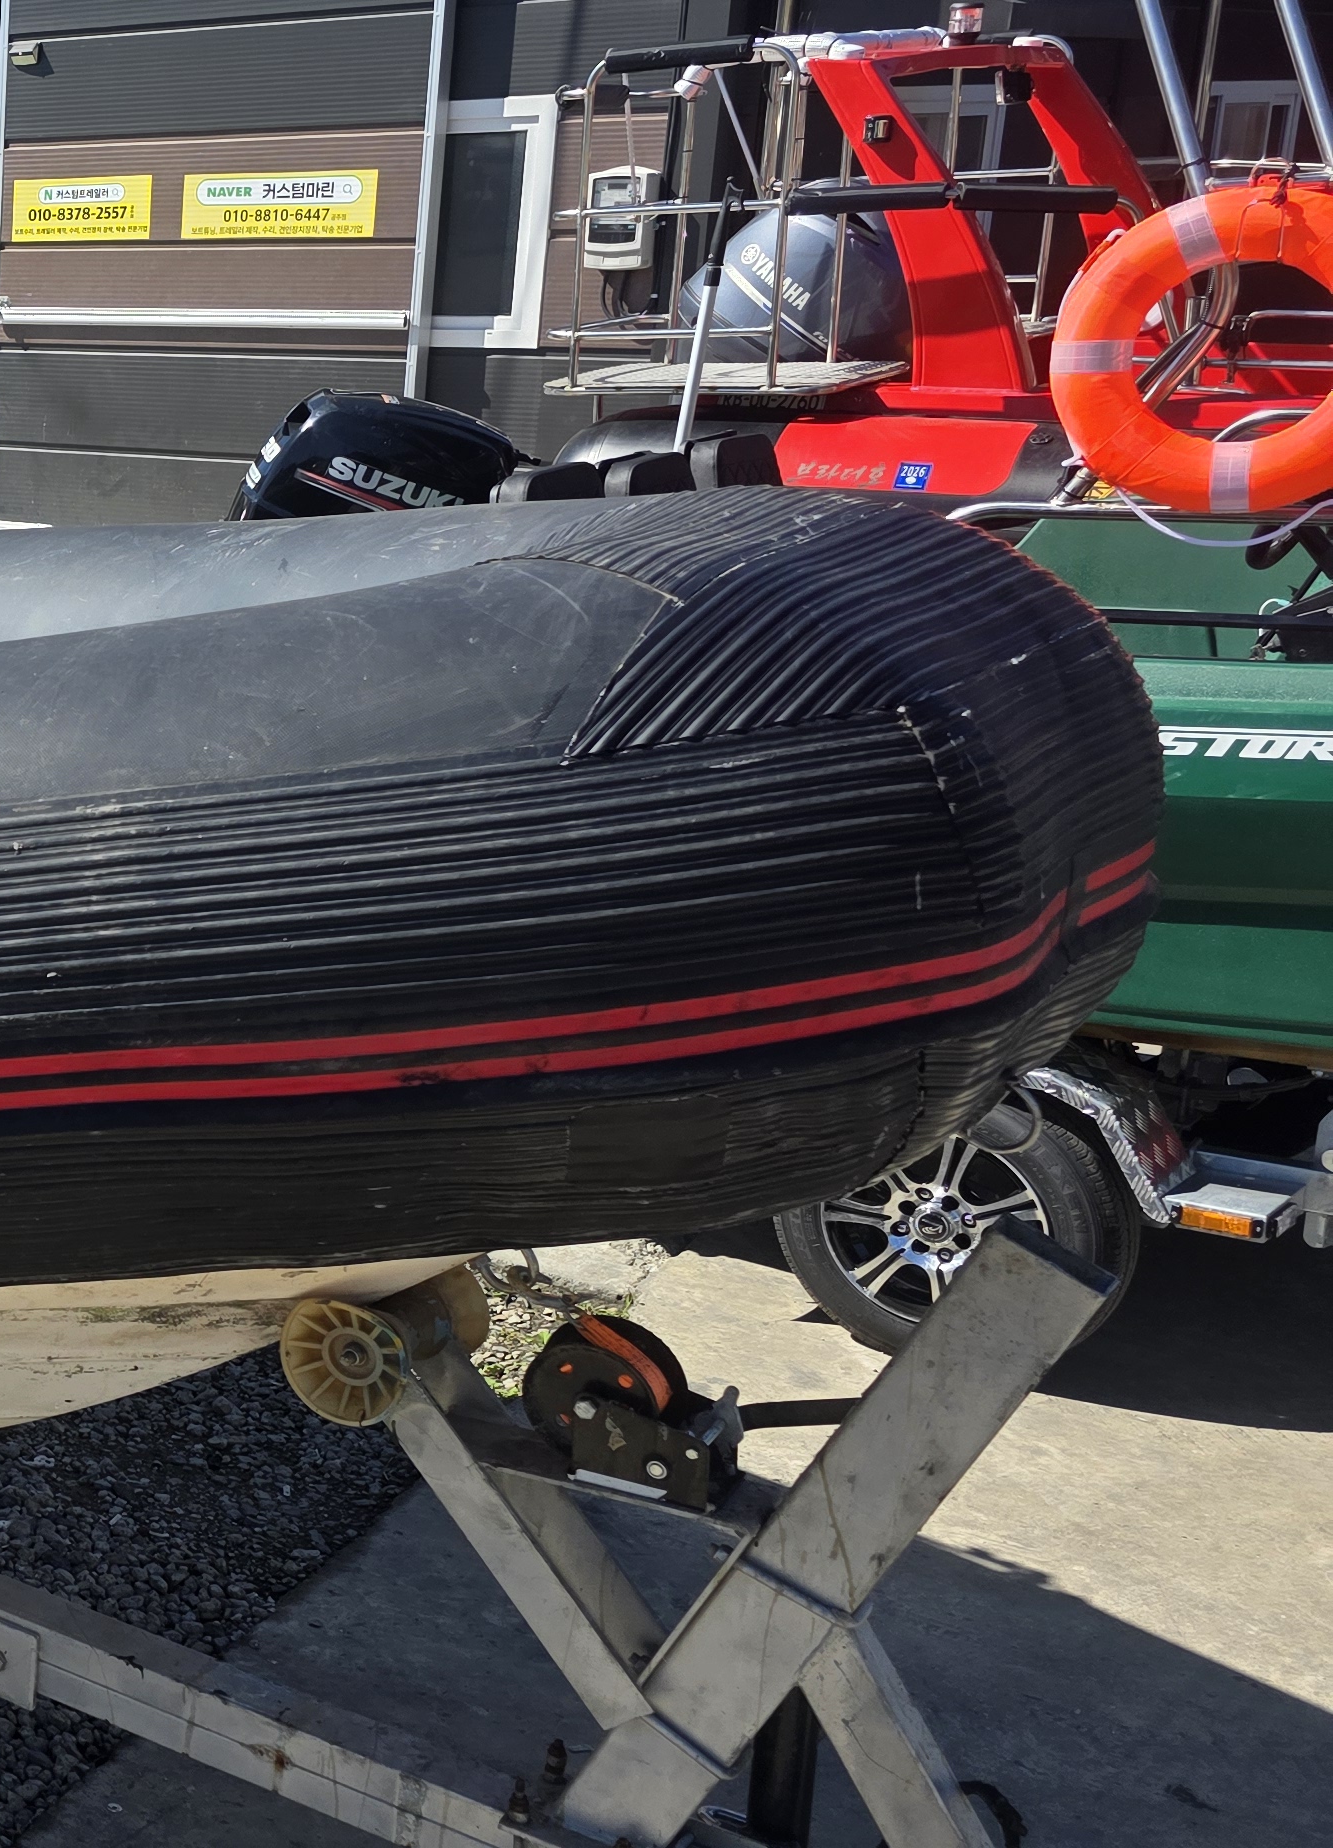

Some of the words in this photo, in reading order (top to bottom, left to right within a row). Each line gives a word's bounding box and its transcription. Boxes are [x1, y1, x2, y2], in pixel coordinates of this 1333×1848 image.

[207, 186, 252, 198] NAVER
[262, 181, 335, 200] 커스텀마린
[28, 205, 127, 221] 010-8378-2557
[223, 208, 330, 222] 010-8810-6447
[900, 465, 927, 478] 2026
[328, 456, 464, 508] SUZUK
